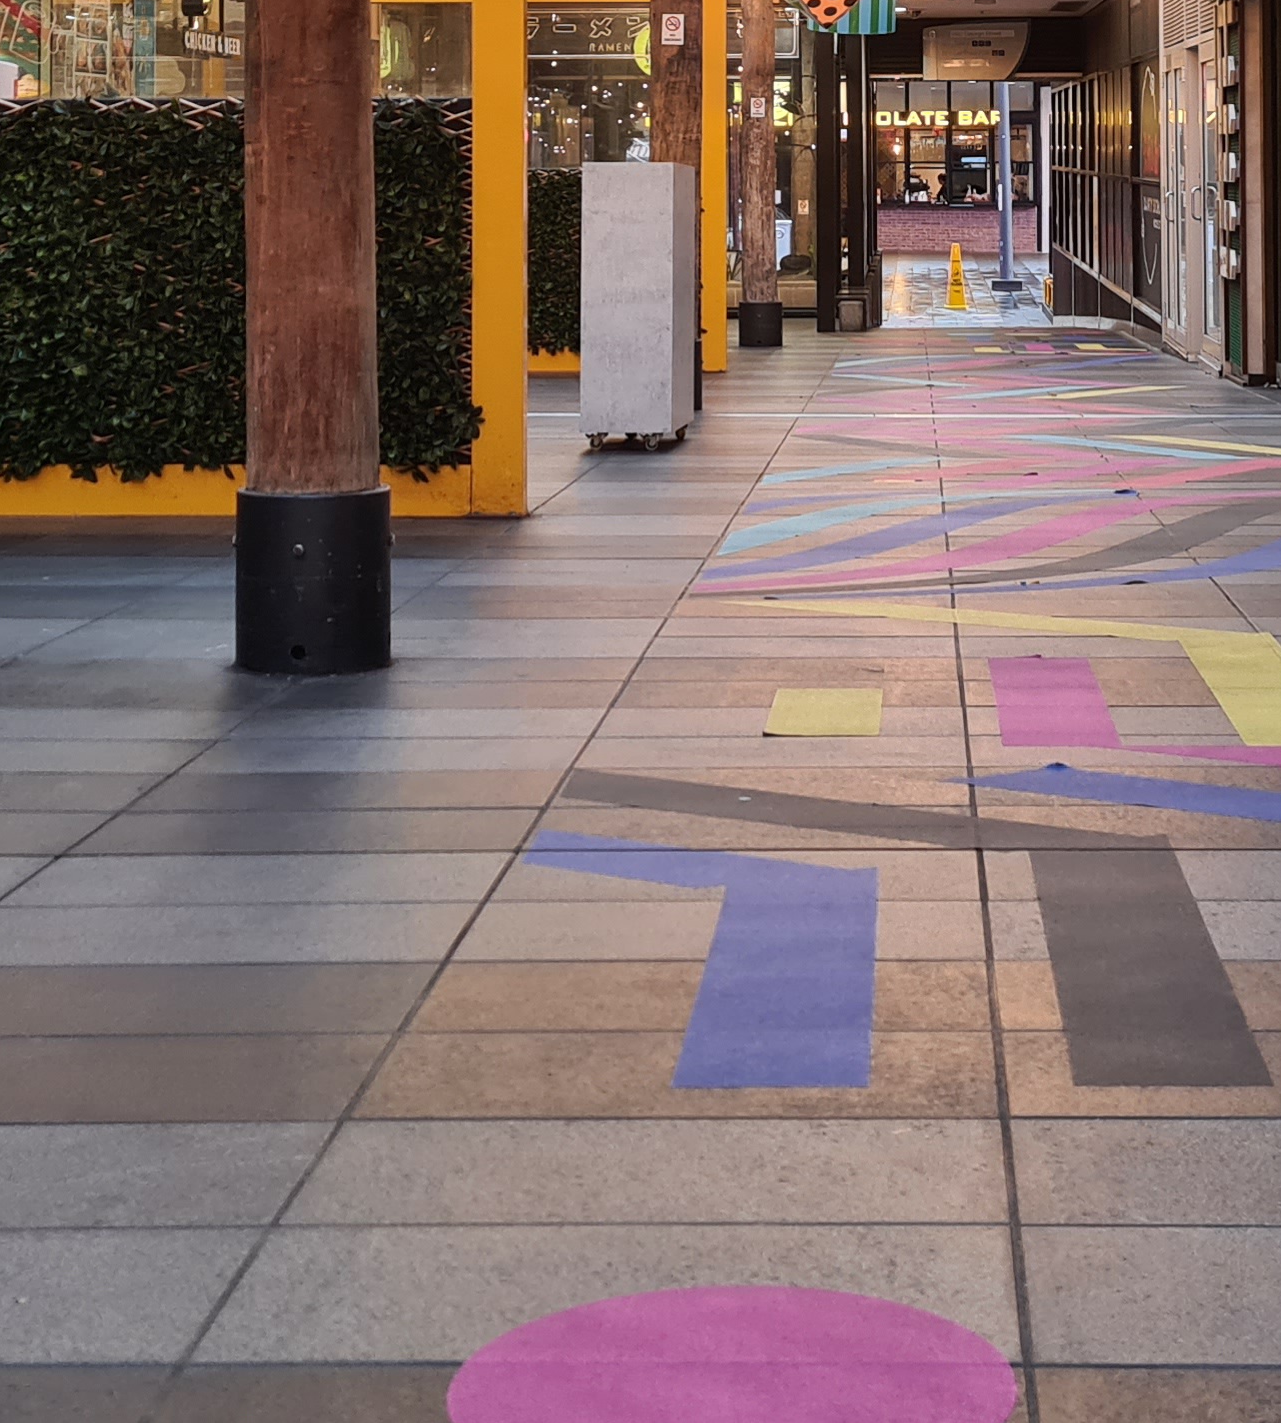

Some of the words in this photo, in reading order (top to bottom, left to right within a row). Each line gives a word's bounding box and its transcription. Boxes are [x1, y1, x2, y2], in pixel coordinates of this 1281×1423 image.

[184, 31, 216, 52] CHICKEN
[224, 36, 241, 56] BEER
[589, 42, 632, 52] RAMEN
[875, 110, 950, 126] OLATE
